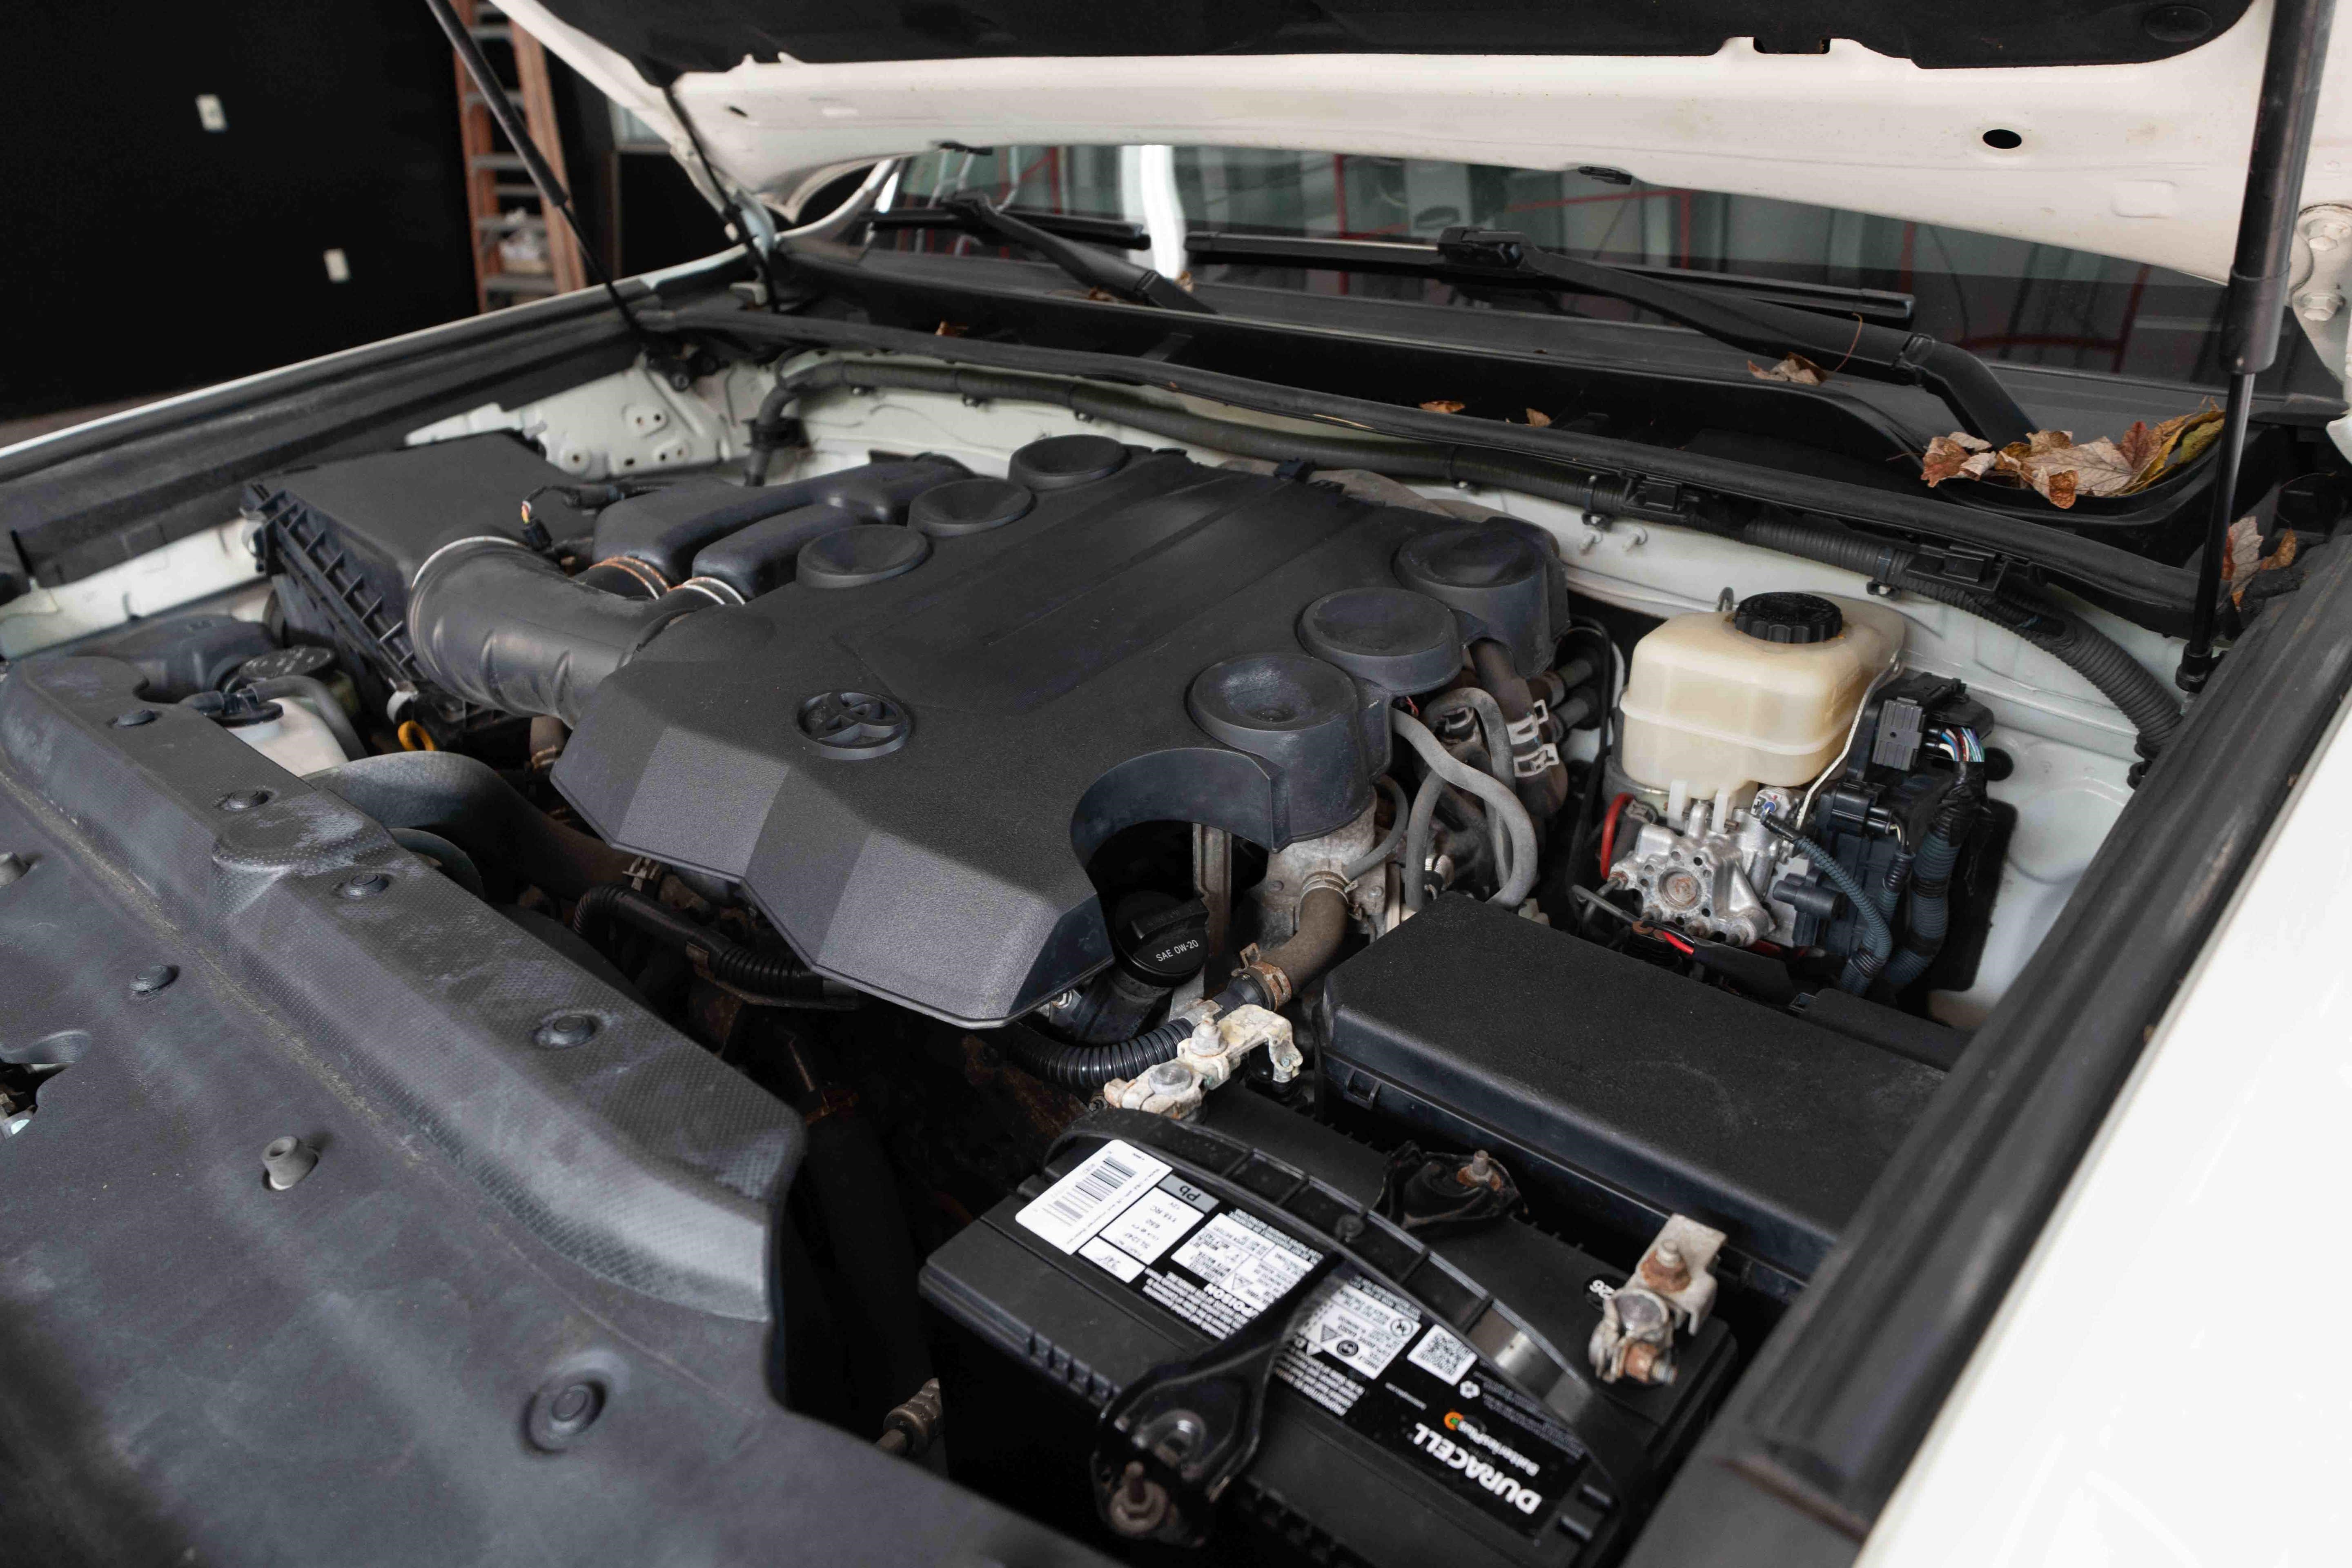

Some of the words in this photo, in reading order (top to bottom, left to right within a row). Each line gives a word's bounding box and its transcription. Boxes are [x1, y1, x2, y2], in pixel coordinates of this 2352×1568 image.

[1156, 950, 1173, 962] SAE
[1174, 939, 1199, 954] 0W-20
[1179, 1185, 1201, 1202] Pb
[1203, 1283, 1254, 1316] POISON
[1457, 1420, 1539, 1476] BatteriesPlus
[1414, 1423, 1541, 1513] DURACELL
